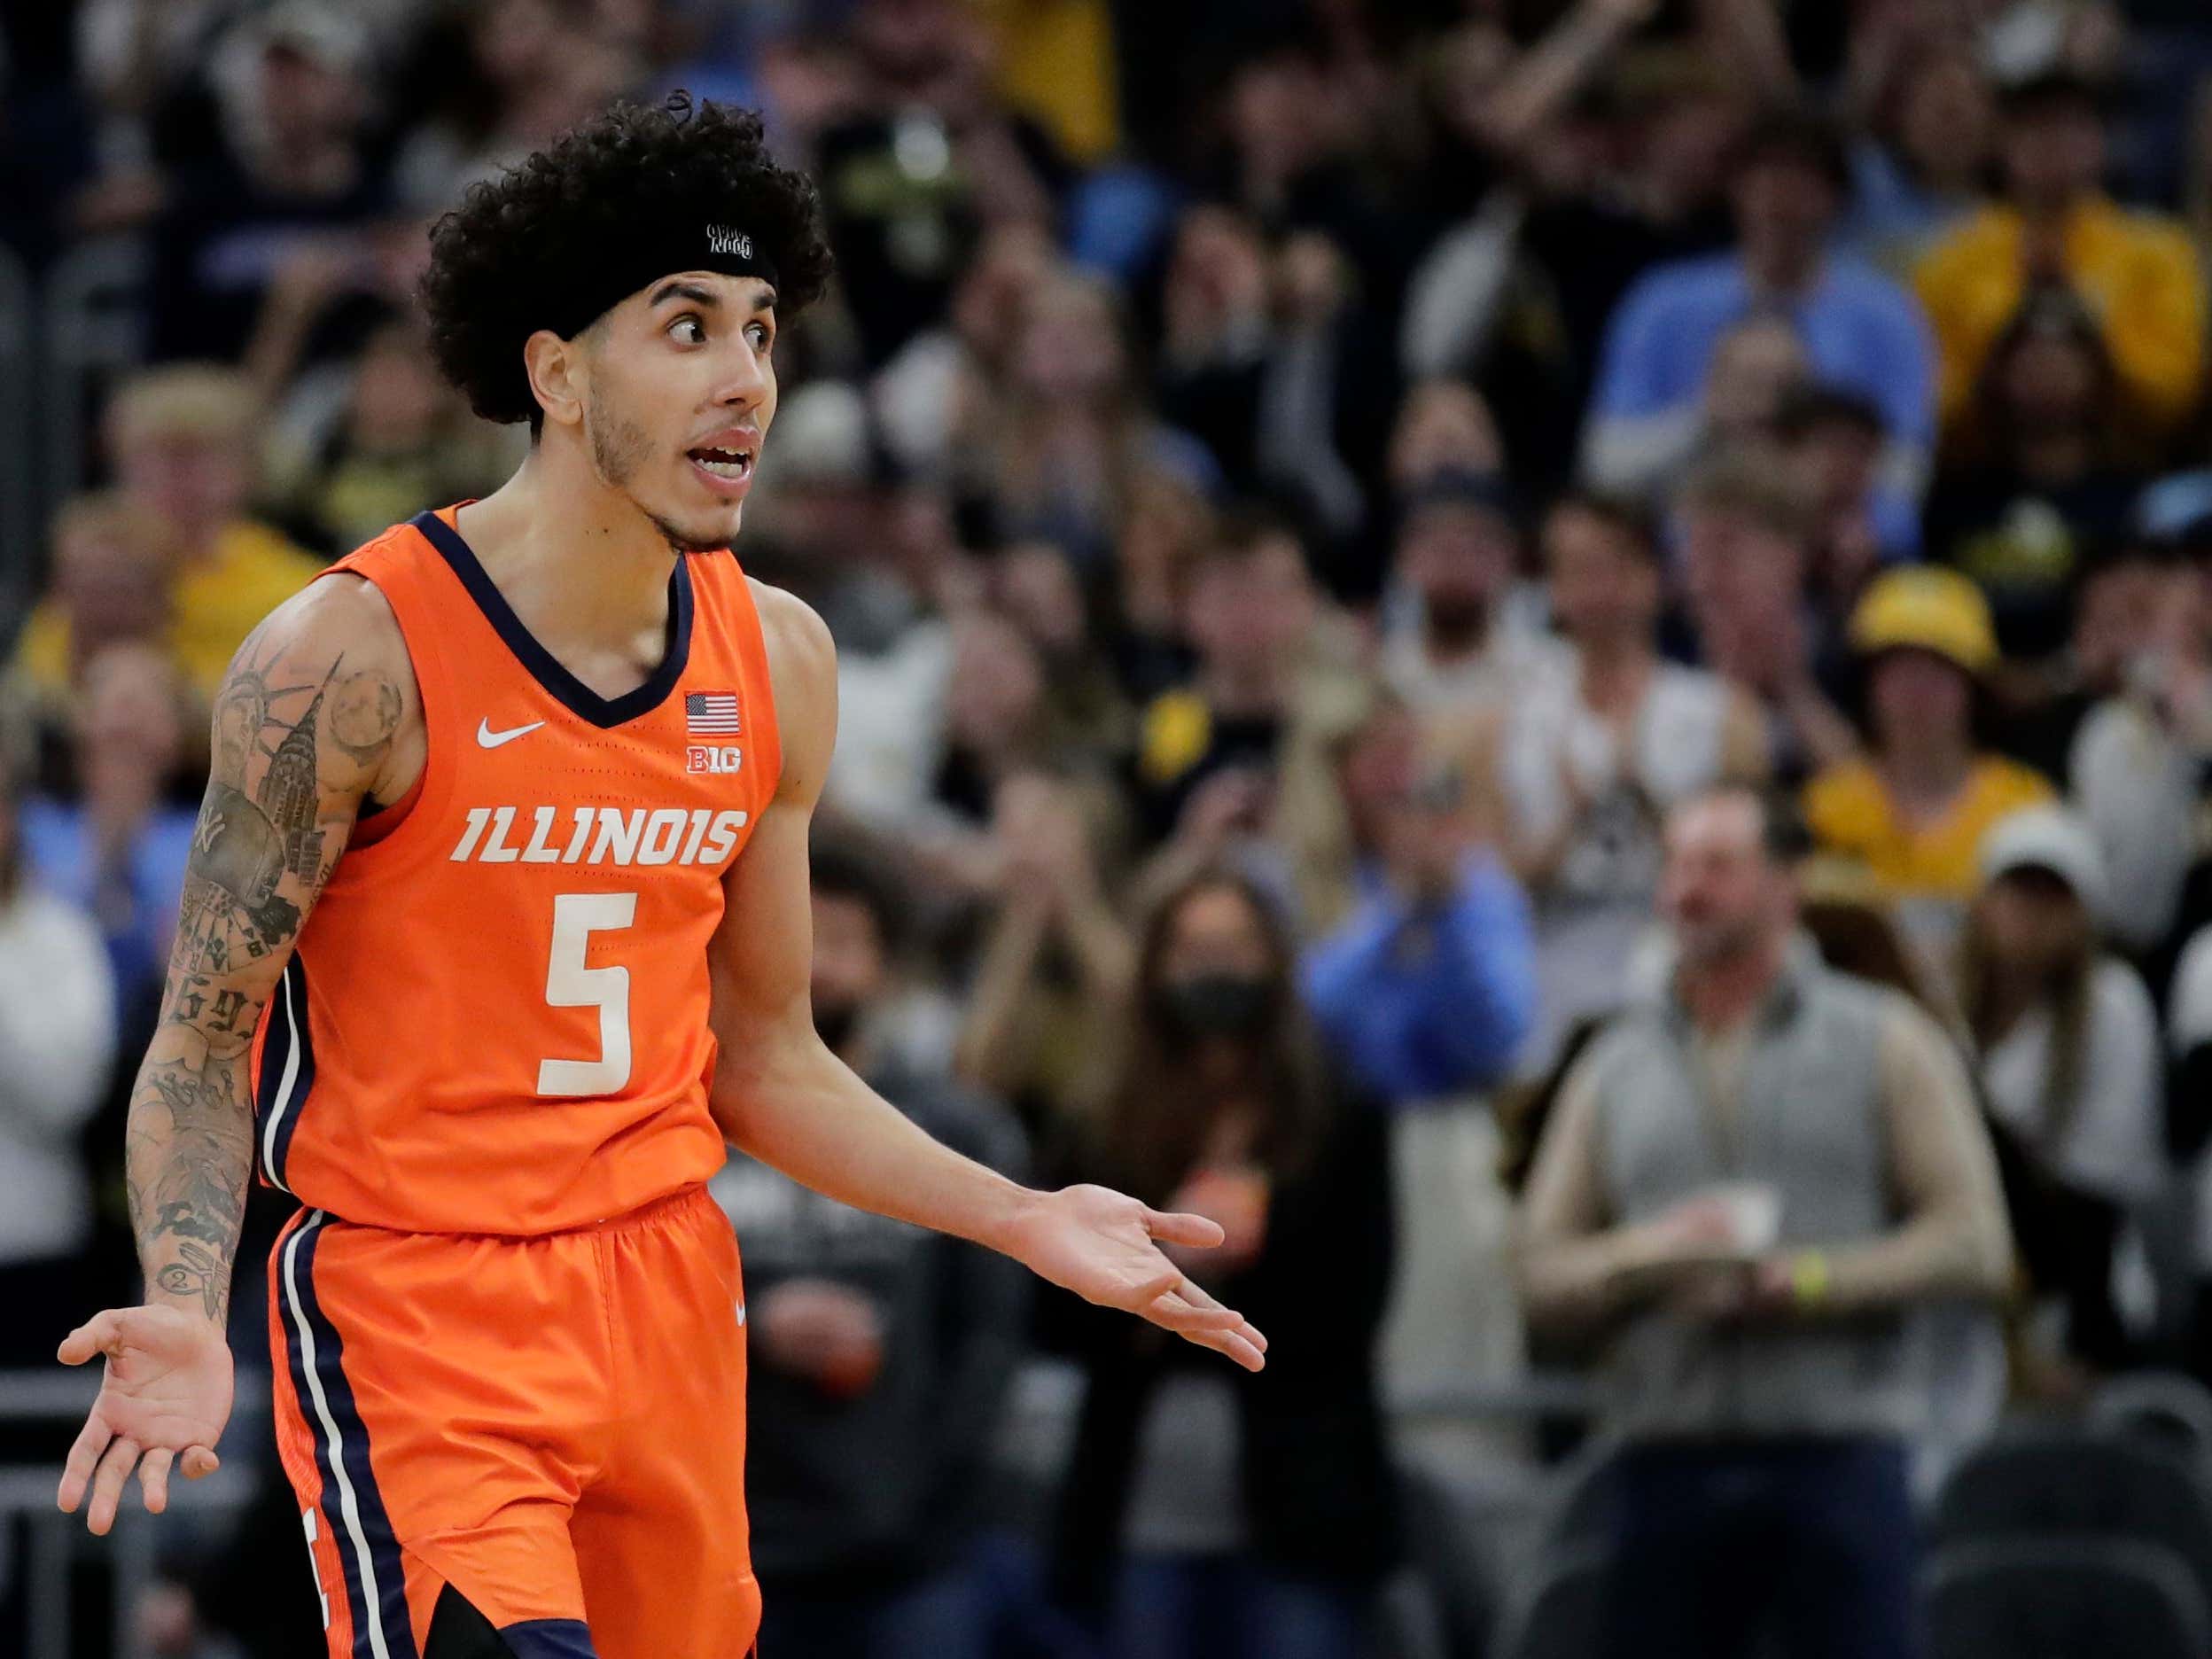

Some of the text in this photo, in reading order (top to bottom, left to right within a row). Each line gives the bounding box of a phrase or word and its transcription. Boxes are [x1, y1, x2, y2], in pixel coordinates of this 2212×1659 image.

[449, 806, 747, 865] ILLINOIS
[536, 892, 637, 1096] 5
[172, 1270, 188, 1288] 2
